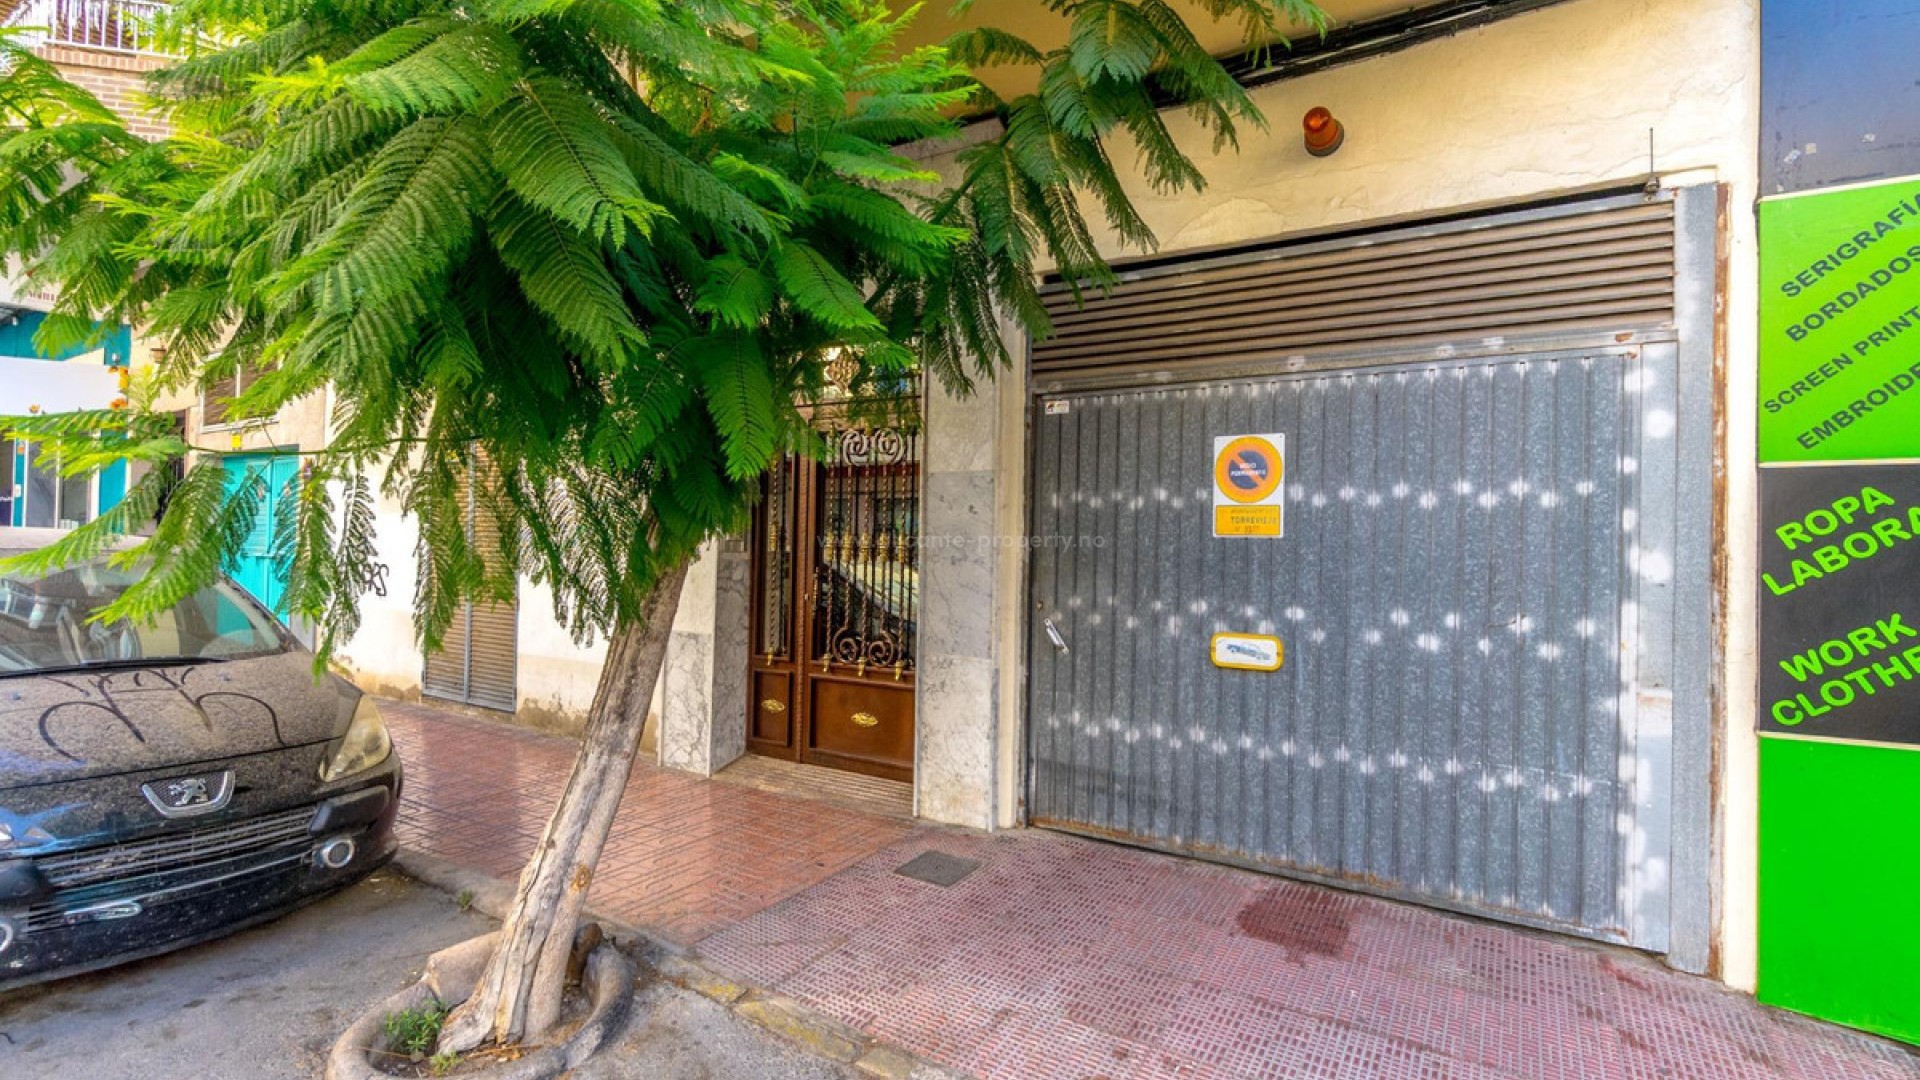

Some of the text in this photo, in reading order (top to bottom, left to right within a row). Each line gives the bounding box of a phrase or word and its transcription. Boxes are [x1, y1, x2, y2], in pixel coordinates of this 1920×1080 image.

[1781, 193, 1920, 297] SERIGRAFÍ
[1785, 245, 1920, 342] BORDADOS
[1764, 353, 1854, 414] SCREEN
[1776, 486, 1895, 550] ROPA
[1779, 612, 1917, 682] WORK
